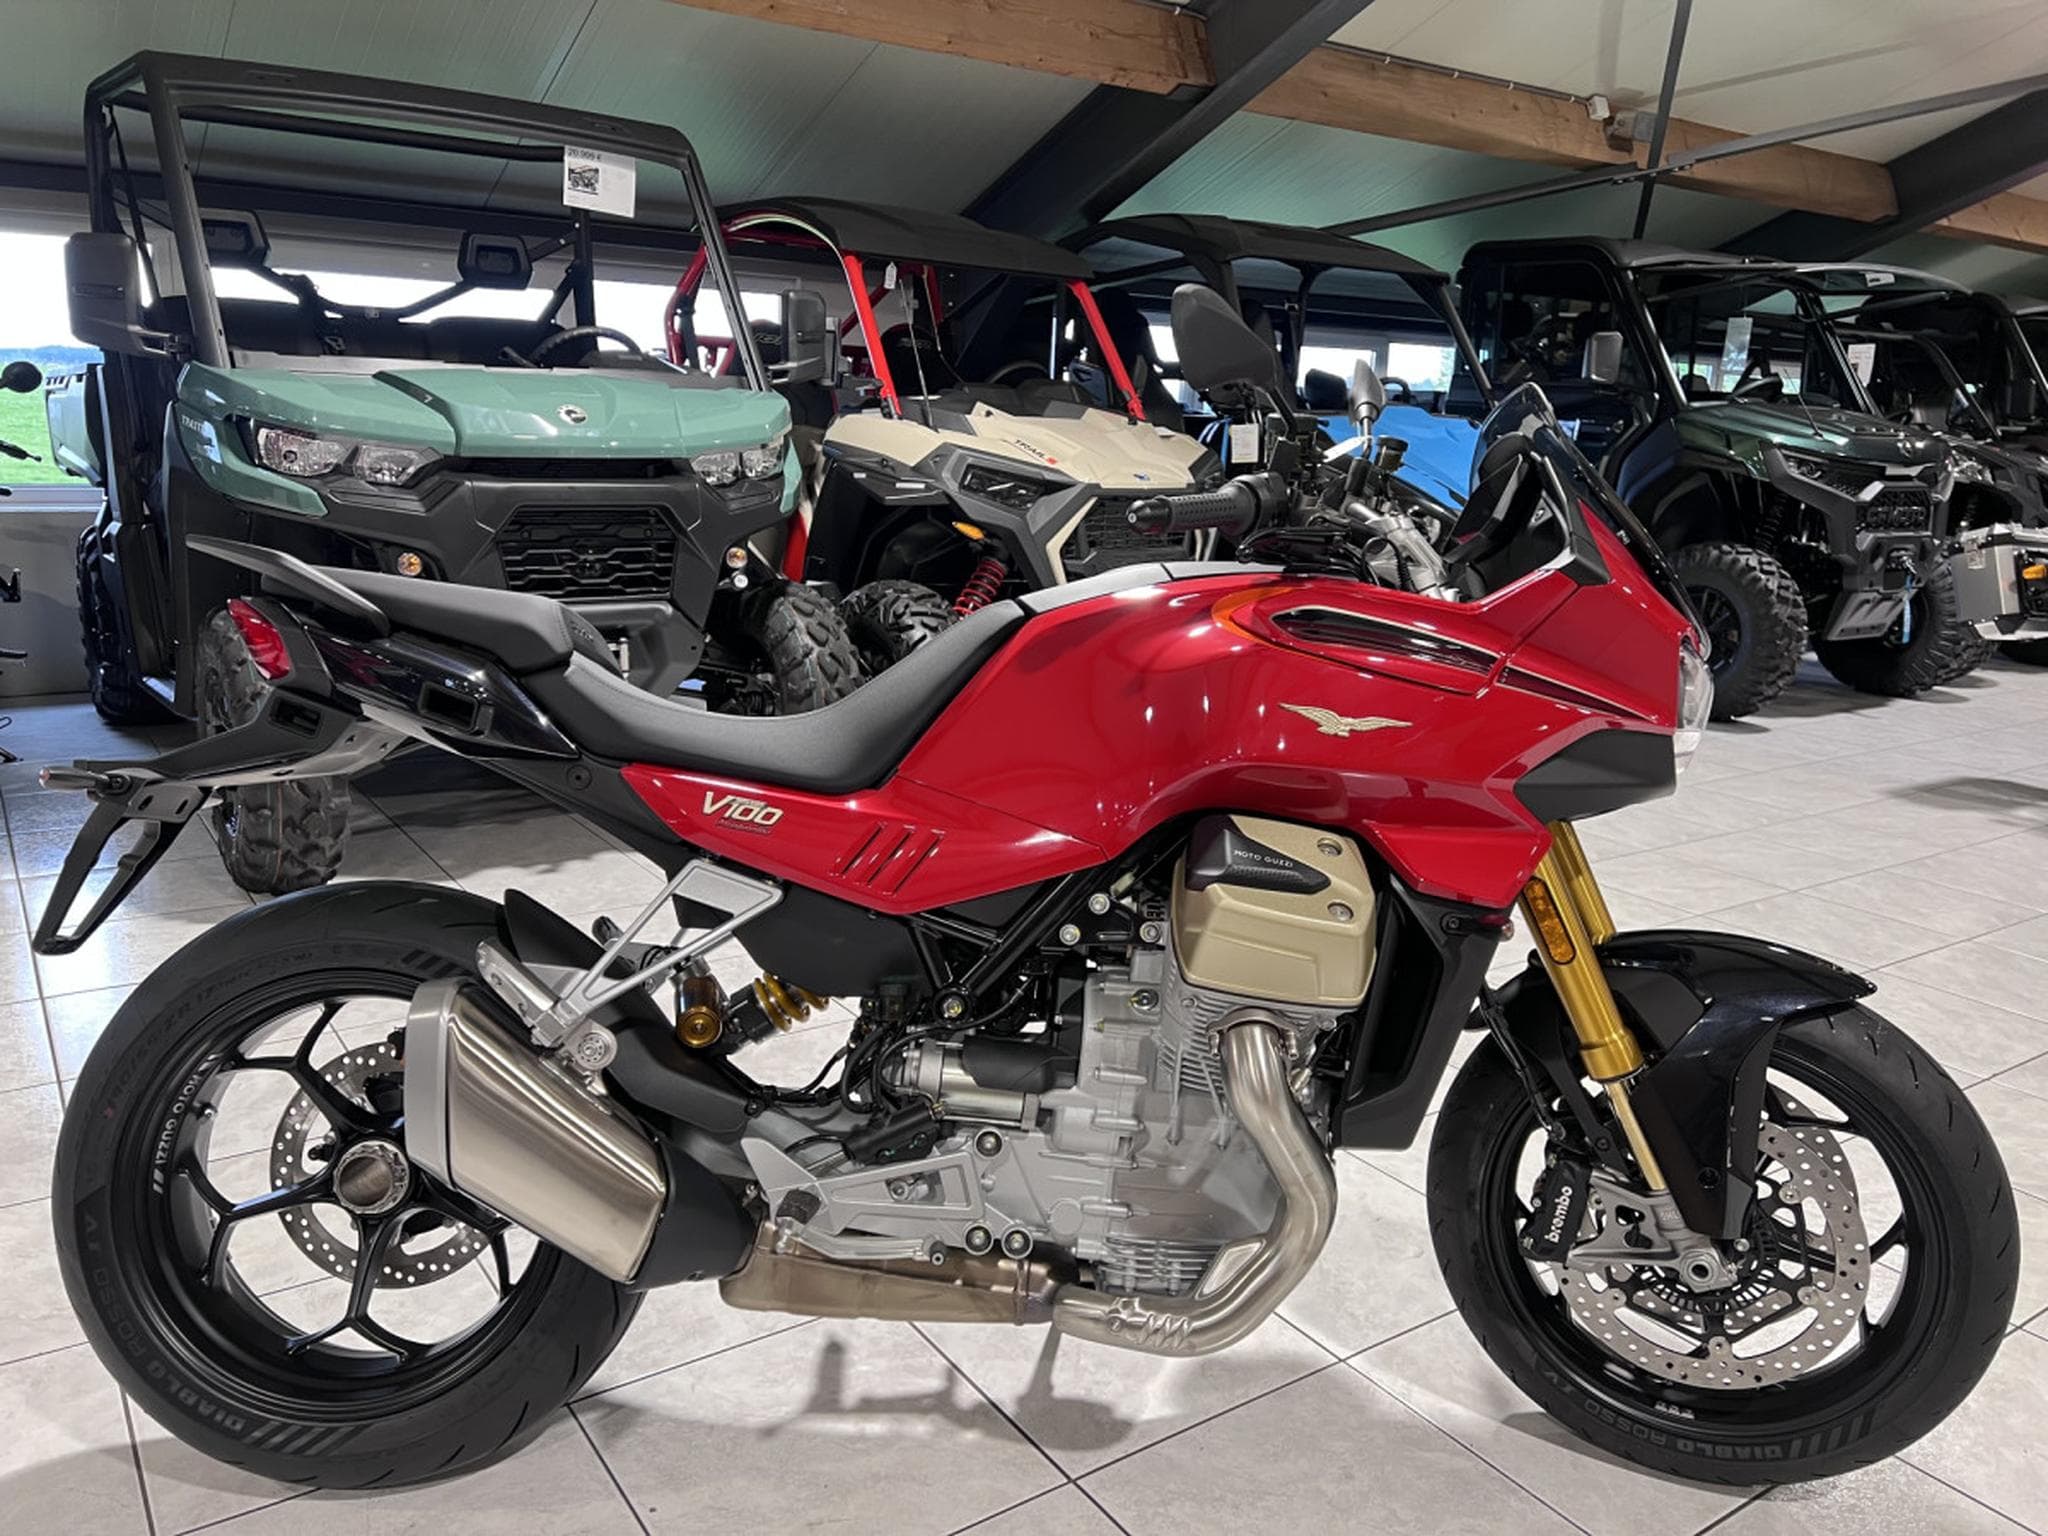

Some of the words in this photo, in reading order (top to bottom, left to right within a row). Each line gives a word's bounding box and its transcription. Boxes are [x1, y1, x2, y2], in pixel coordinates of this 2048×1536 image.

[702, 791, 784, 827] V100
[1233, 849, 1262, 861] MOTO
[1263, 855, 1294, 868] GUZZI
[154, 1118, 178, 1165] GUZZI
[1544, 1185, 1573, 1244] brembo
